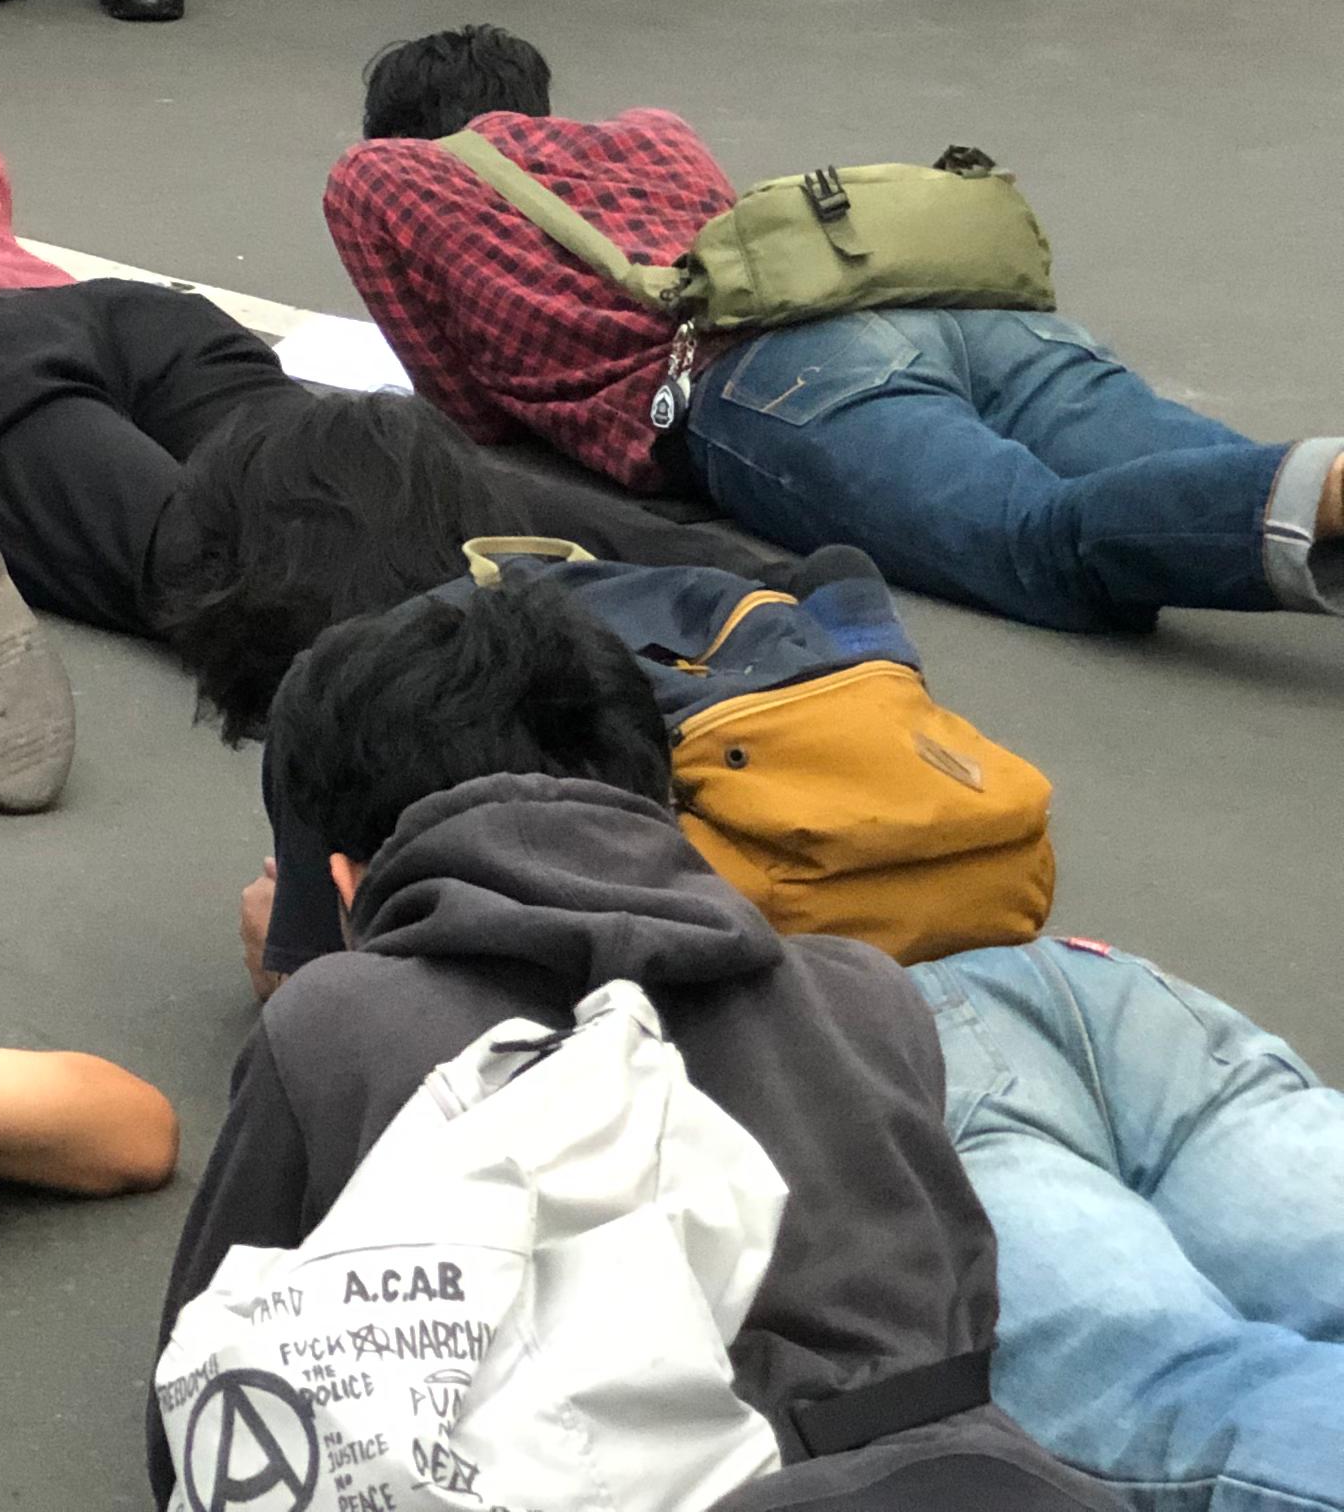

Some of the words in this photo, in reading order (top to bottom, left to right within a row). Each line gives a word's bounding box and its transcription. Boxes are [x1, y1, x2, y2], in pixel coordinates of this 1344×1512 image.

[280, 1335, 347, 1366] FUCK
[299, 1372, 375, 1407] POLICE
[302, 1364, 336, 1383] THE
[327, 1433, 390, 1474] JUSTICE
